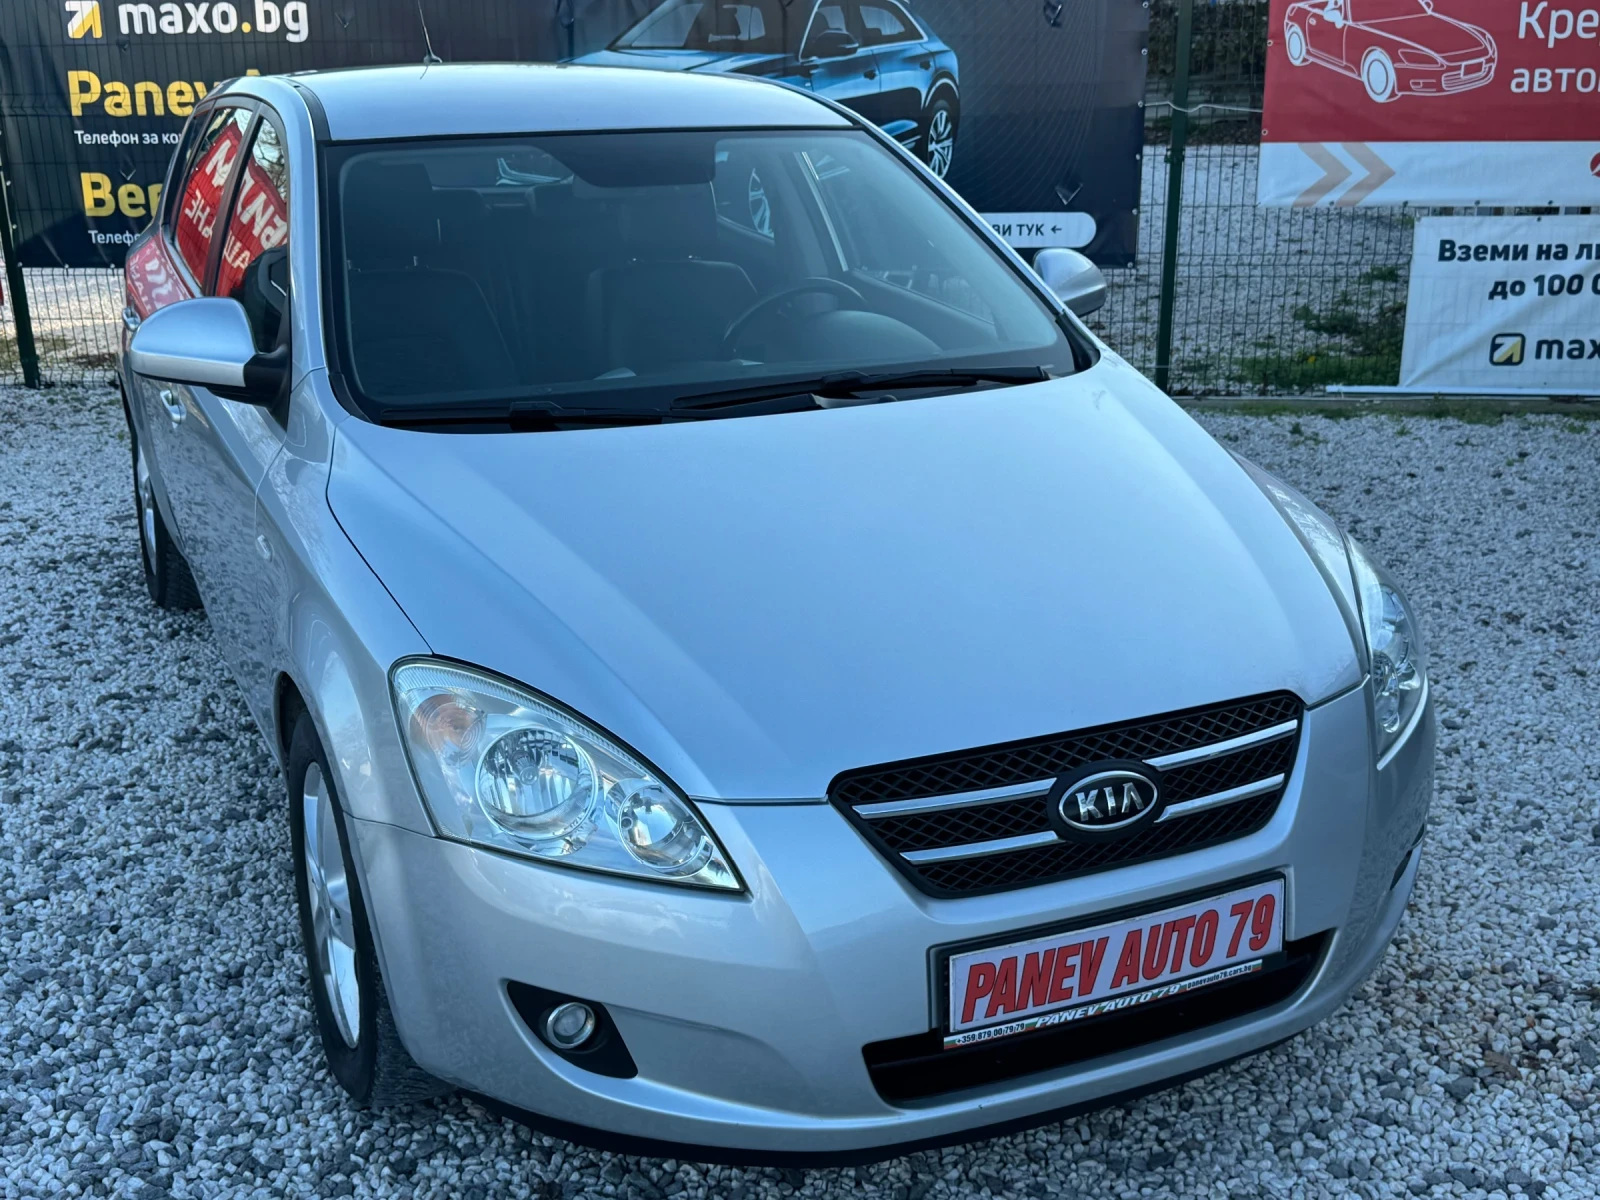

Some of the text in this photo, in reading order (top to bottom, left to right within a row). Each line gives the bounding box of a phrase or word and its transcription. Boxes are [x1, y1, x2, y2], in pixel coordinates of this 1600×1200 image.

[118, 0, 309, 43] maxo.bg
[1518, 1, 1600, 49] Кре
[1510, 67, 1600, 94] авто
[74, 129, 181, 148] Телефон за ко
[1016, 223, 1045, 237] ТУК
[1438, 239, 1529, 262] Вземи
[1535, 243, 1569, 262] на
[1488, 279, 1526, 301] до
[1533, 273, 1584, 297] 100
[1534, 338, 1600, 361] max
[1075, 781, 1145, 823] KIA
[960, 893, 1276, 1024] PANEV AUTO 79
[956, 1033, 976, 1044] +359
[978, 1030, 991, 1041] 879
[994, 1027, 1003, 1037] 00
[1004, 1025, 1014, 1035] 79
[1015, 1022, 1025, 1032] 79
[1035, 1004, 1100, 1028] PANEV
[1102, 991, 1153, 1013] AUTO
[1157, 984, 1181, 999] 79
